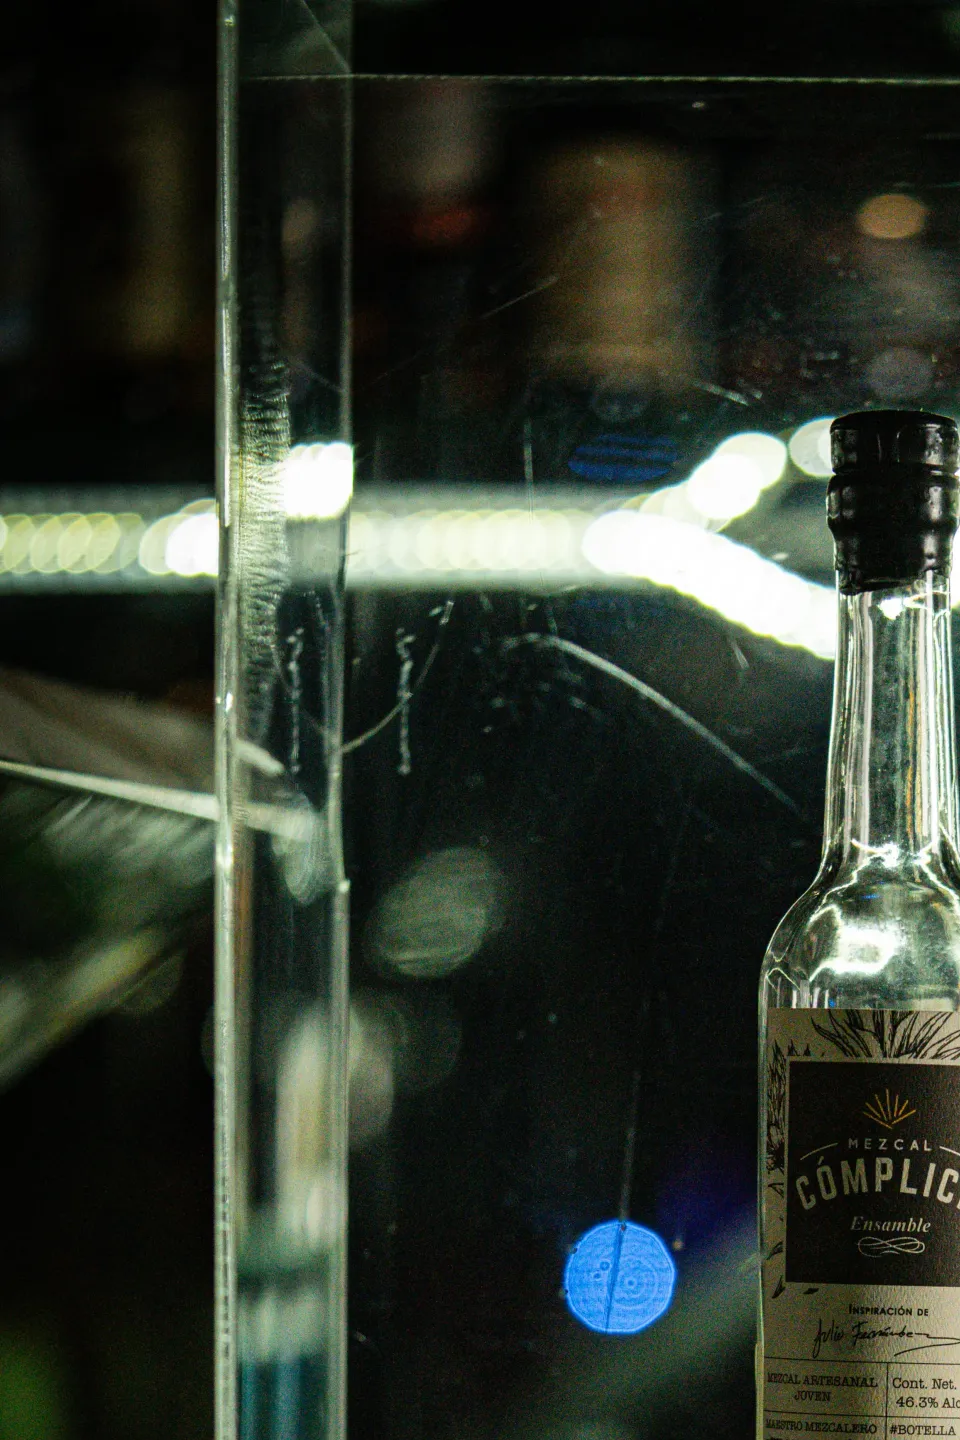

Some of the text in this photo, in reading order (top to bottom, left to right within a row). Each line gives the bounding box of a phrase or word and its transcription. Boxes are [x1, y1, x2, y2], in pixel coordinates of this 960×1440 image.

[848, 1138, 933, 1151] MEZCAL
[850, 1216, 931, 1233] Ensamble
[917, 1308, 929, 1317] DE
[767, 1372, 878, 1388] MEZCAL ARTESANAL
[892, 1378, 928, 1390] Cont.
[932, 1378, 957, 1390] Net.
[794, 1390, 831, 1402] JOVEN
[895, 1396, 939, 1409] 46.3%
[805, 1421, 877, 1434] MEZCALERO
[890, 1424, 956, 1436] #BOTELLA
